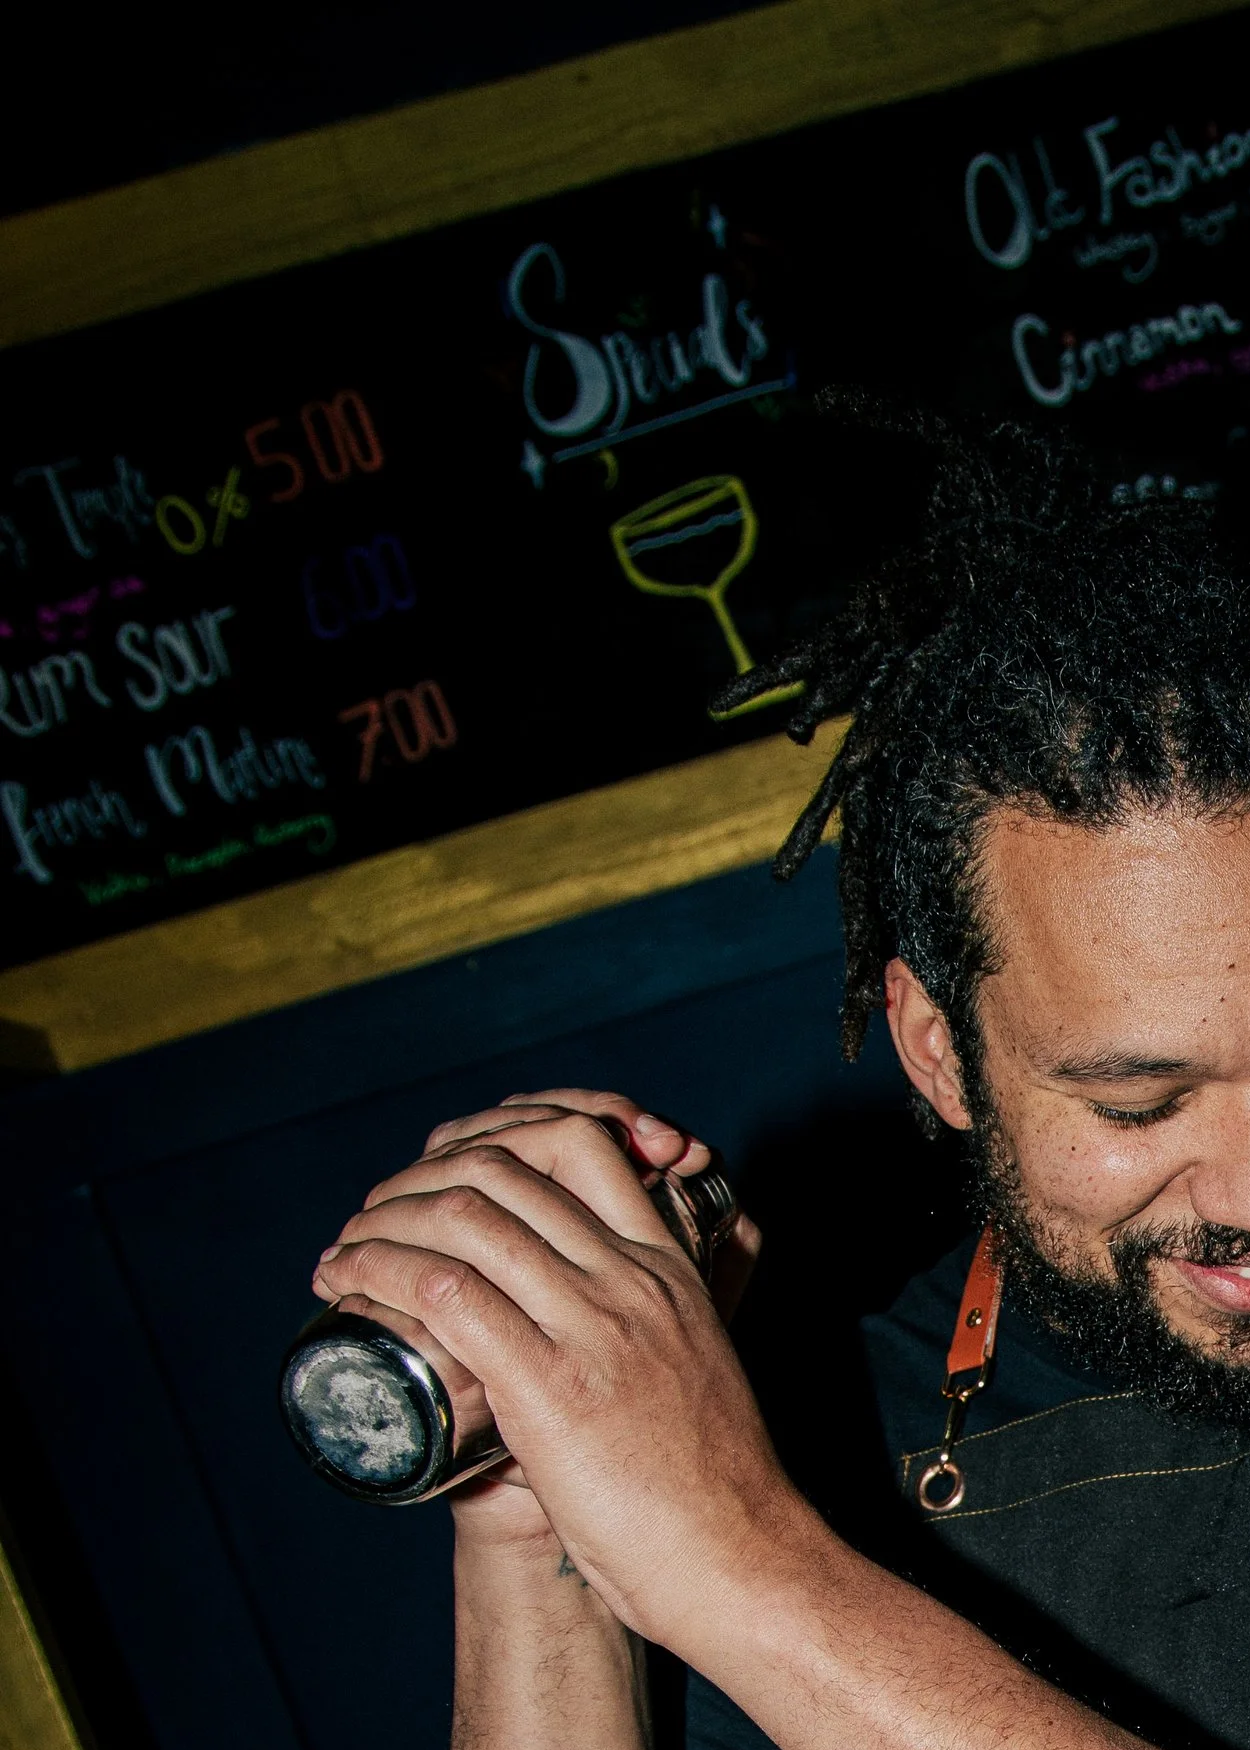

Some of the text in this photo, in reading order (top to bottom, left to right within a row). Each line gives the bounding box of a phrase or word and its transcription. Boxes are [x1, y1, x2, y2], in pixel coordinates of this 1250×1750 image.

[1012, 300, 1244, 409] Cinnamon
[155, 465, 250, 556] 0%
[115, 603, 239, 713] Sour
